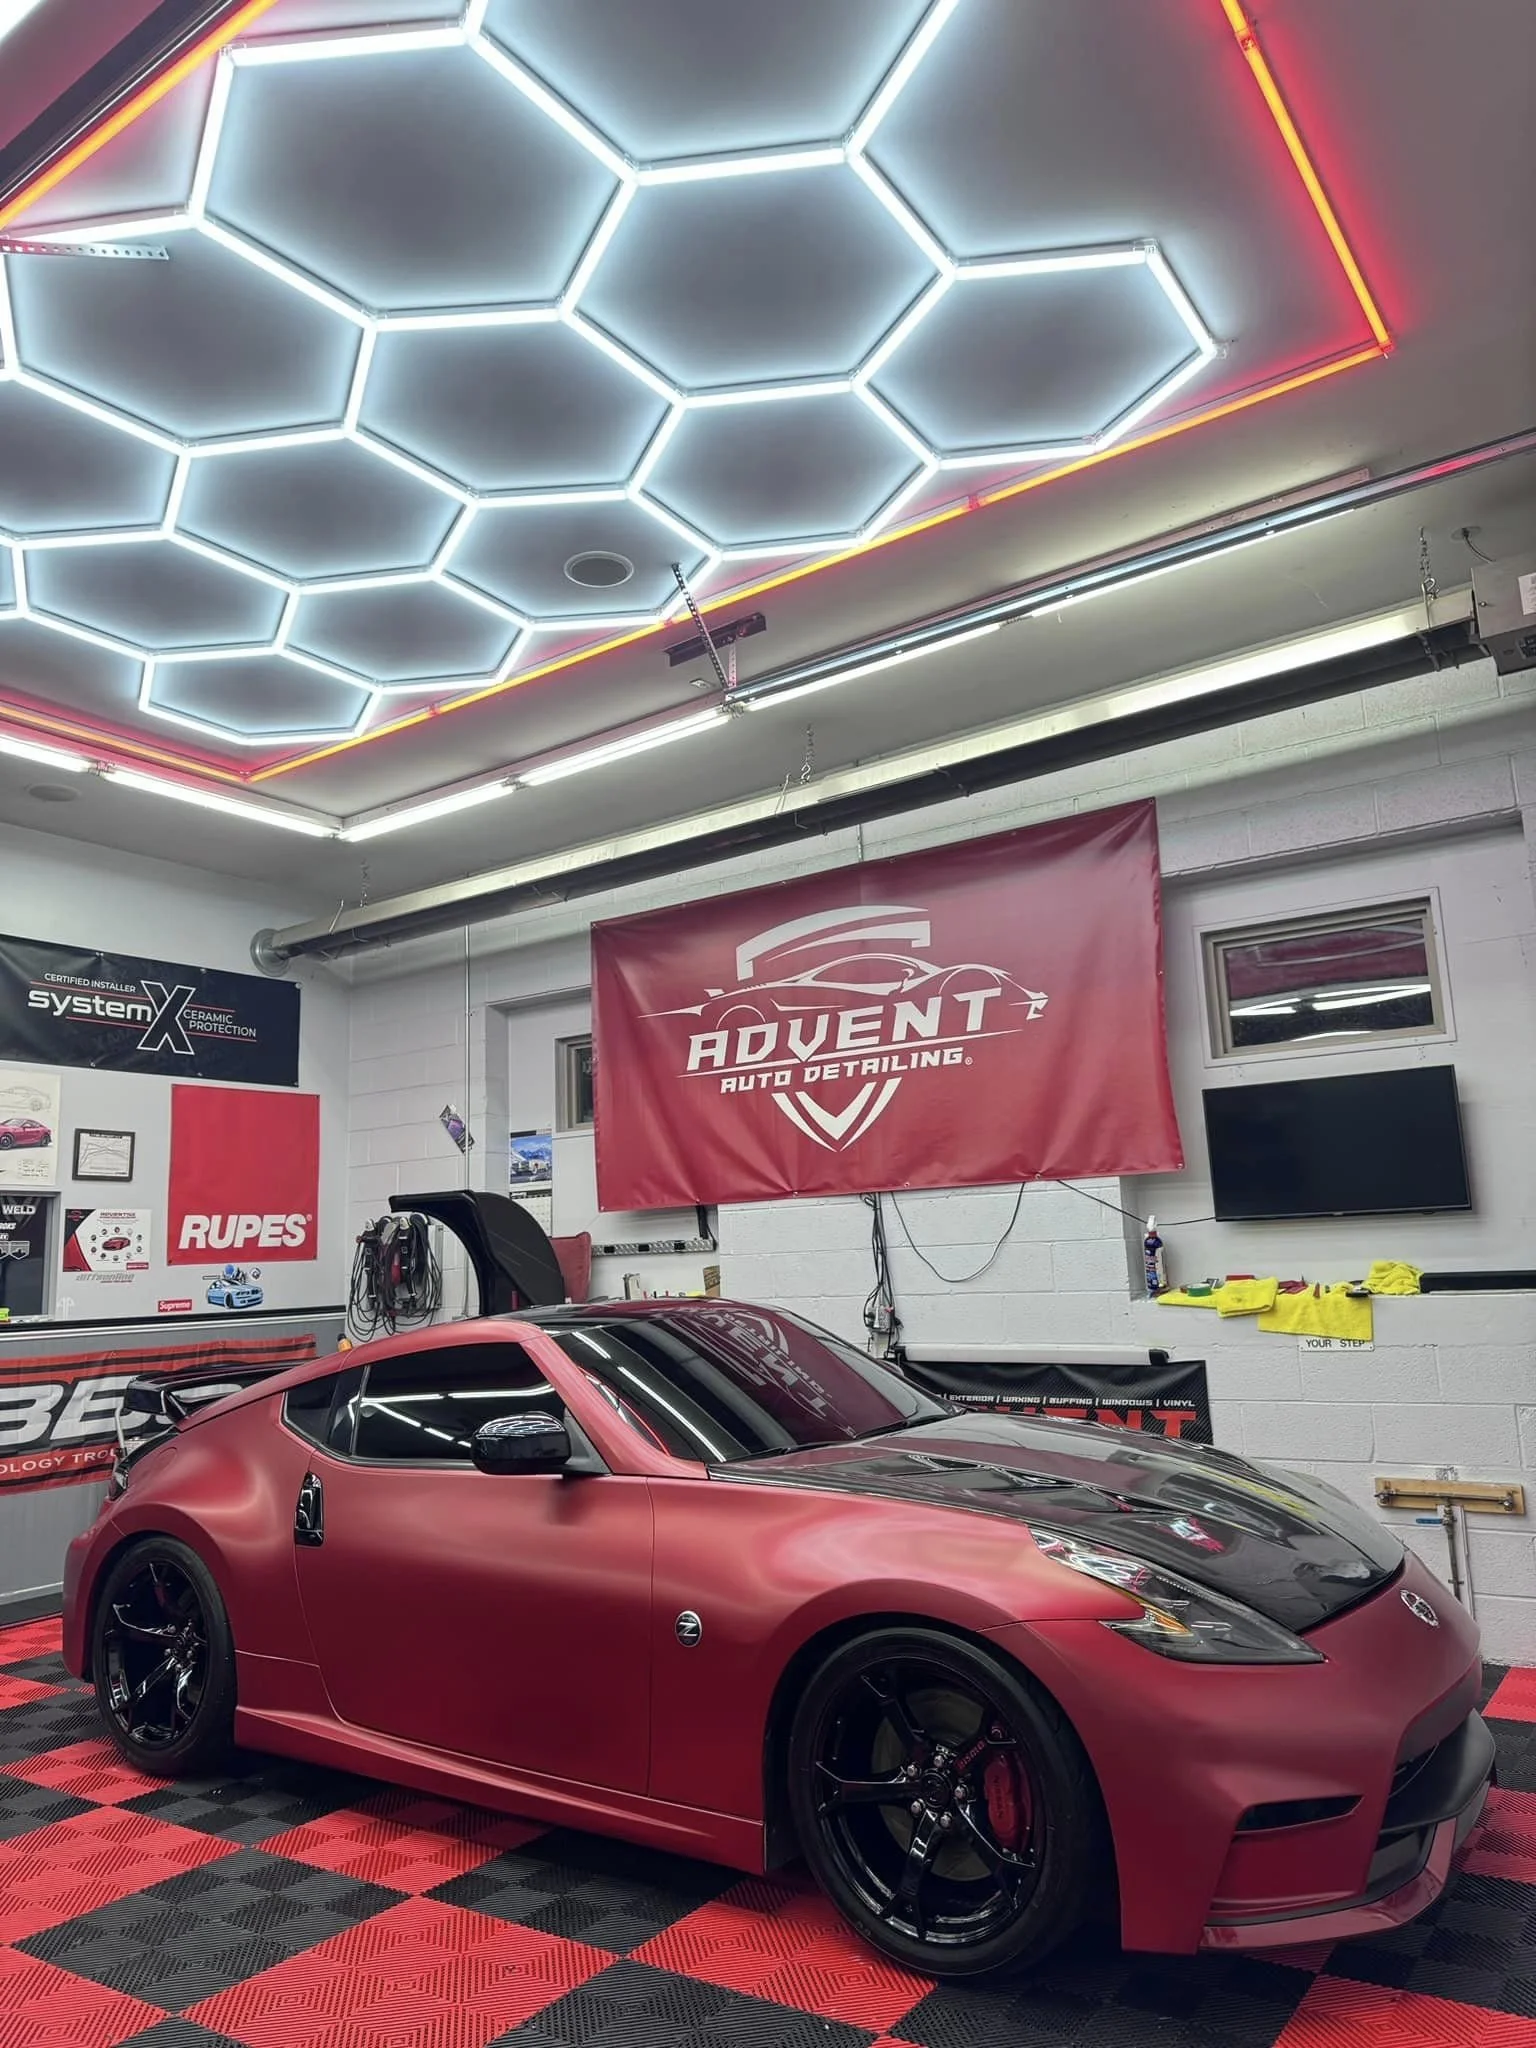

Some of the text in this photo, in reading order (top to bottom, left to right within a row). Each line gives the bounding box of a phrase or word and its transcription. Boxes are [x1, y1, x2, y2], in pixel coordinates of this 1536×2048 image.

[44, 972, 137, 993] CERTIFIED INSTALLER
[183, 1008, 233, 1025] CERAMIC
[189, 1021, 257, 1037] PROTECTION
[686, 987, 1002, 1071] ADVENT
[720, 1070, 792, 1094] AUTO
[2, 1204, 37, 1215] WELD
[159, 1301, 191, 1311] Supreme
[1305, 1339, 1366, 1348] YOUR STEP
[950, 1394, 994, 1403] EXTERIOR
[1003, 1396, 1041, 1404] WAXING
[1049, 1397, 1092, 1405] BUFFING
[1102, 1399, 1152, 1407] WINDOWS
